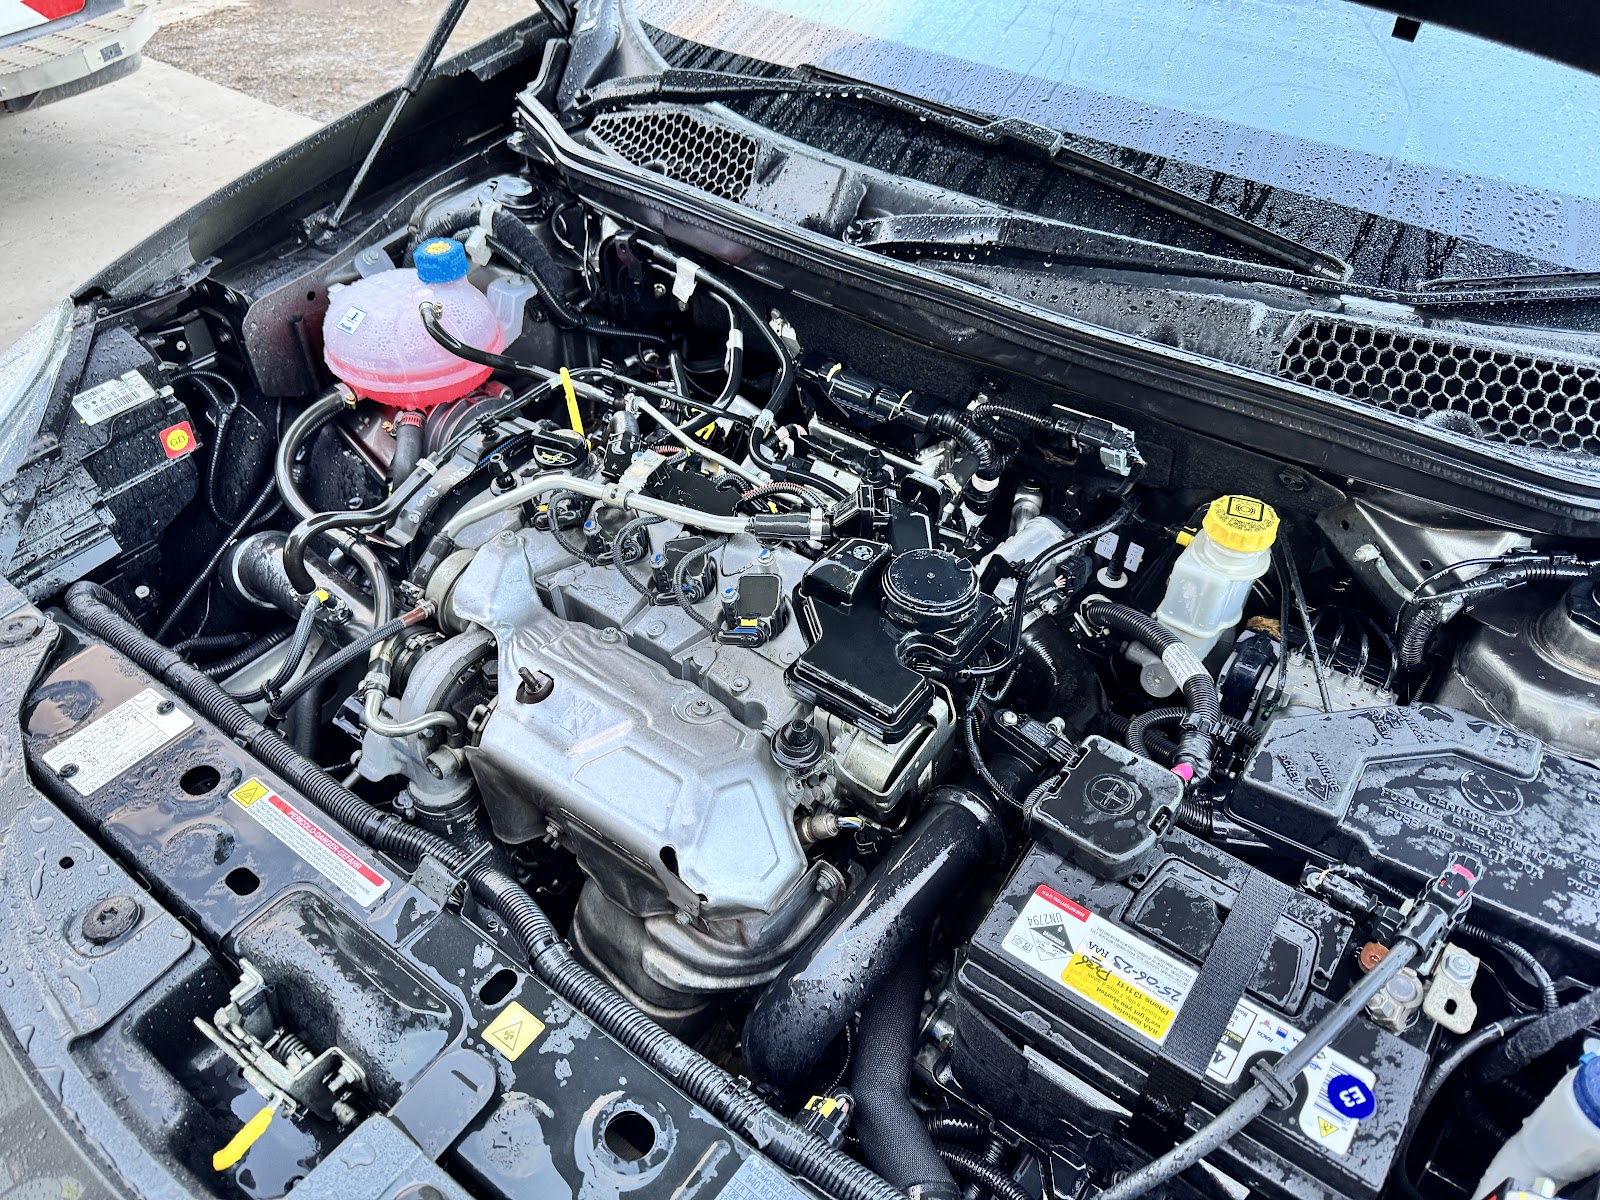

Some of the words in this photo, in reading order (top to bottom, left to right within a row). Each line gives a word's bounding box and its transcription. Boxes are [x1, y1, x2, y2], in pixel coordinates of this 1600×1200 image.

[169, 435, 187, 447] GD
[1278, 753, 1302, 787] SCREW
[287, 809, 362, 870] PERICOLO-DANGER-GEFAHR
[1026, 913, 1061, 924] UN2794
[1086, 940, 1109, 958] RAA
[1095, 986, 1120, 1003] started
[1110, 1002, 1142, 1025] Batteries,
[1119, 999, 1132, 1010] you
[1144, 996, 1170, 1015] Phone
[1141, 1022, 1158, 1035] RAA
[1339, 1086, 1366, 1108] E3
[745, 1163, 788, 1199] AUTOMOBILES
[745, 1174, 760, 1189] 940
[774, 1177, 797, 1196] GROUP
